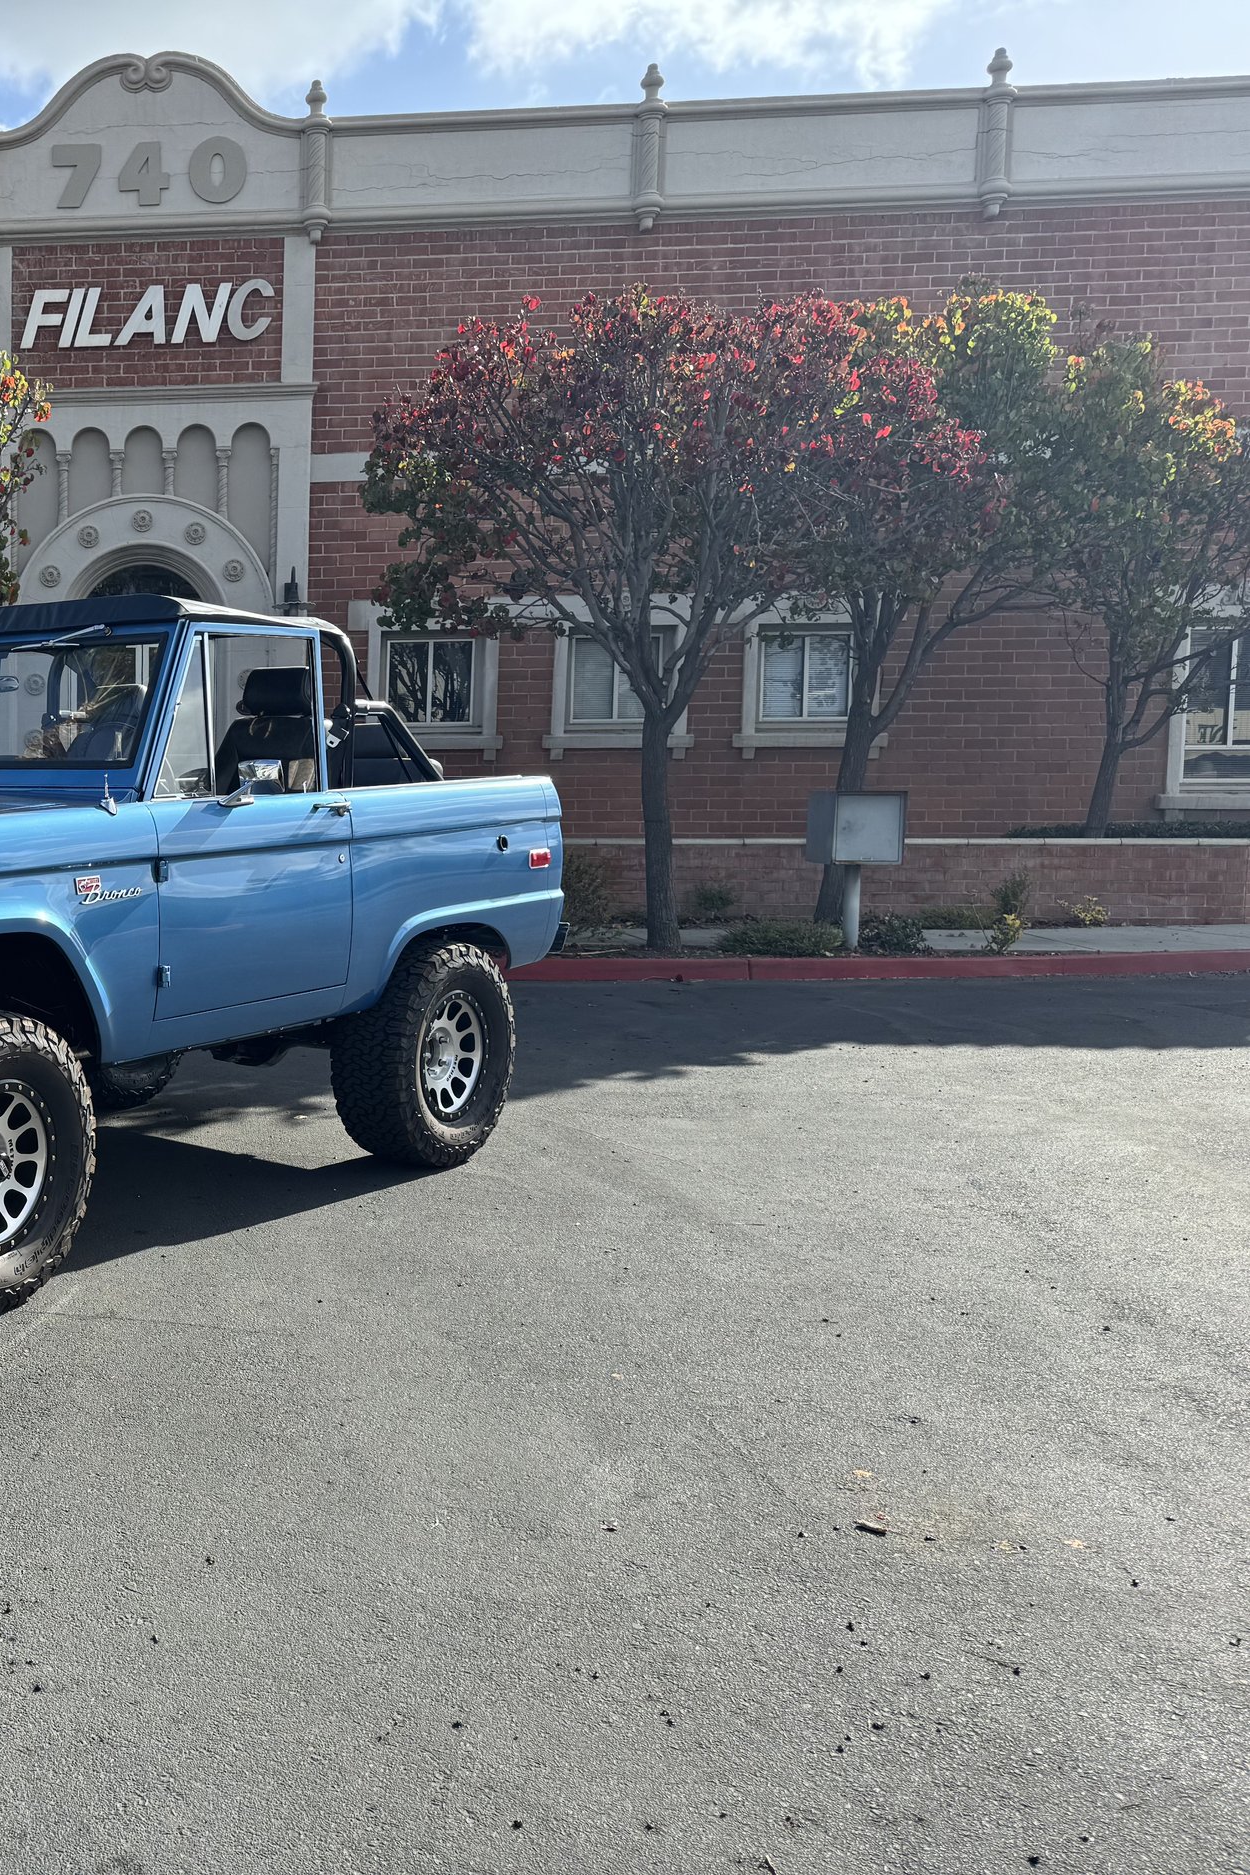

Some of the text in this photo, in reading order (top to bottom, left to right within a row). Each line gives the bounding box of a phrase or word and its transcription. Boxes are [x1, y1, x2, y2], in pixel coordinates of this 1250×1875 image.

[51, 135, 247, 209] 740
[20, 279, 275, 349] FILANC
[80, 884, 142, 905] Bronco
